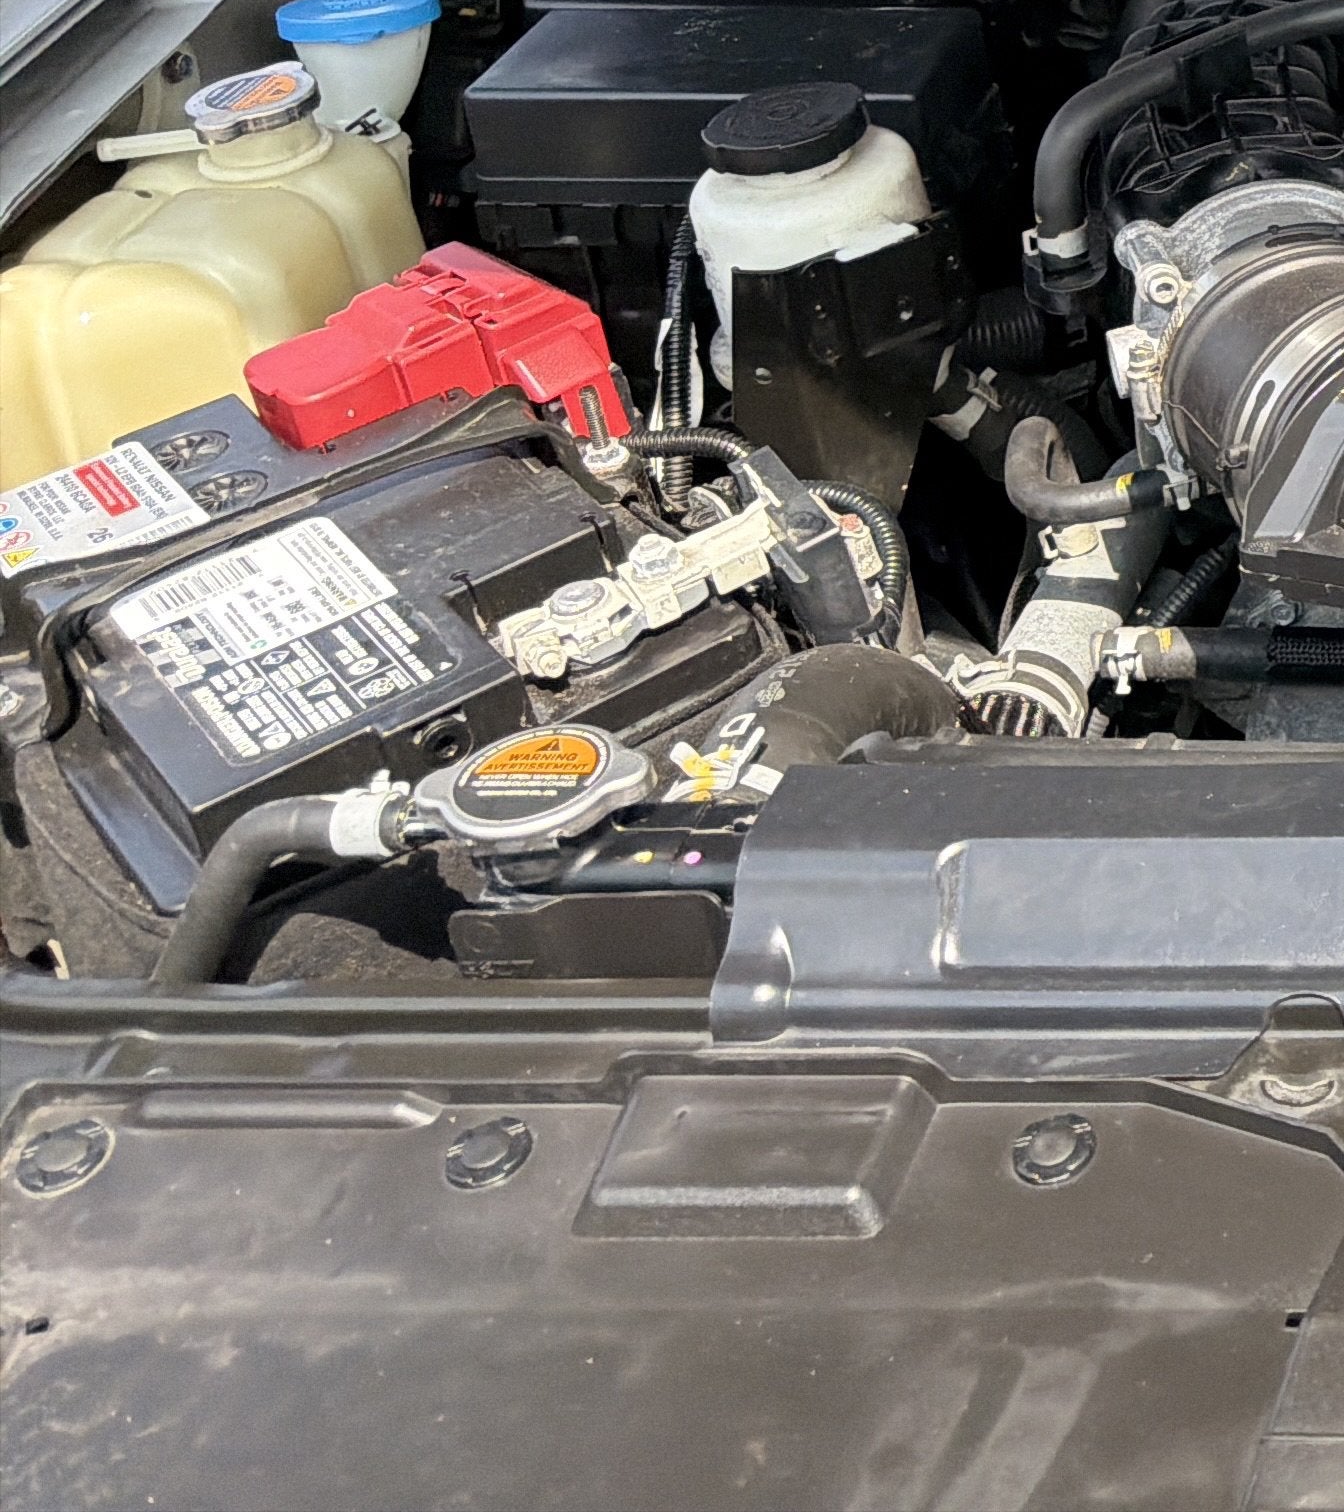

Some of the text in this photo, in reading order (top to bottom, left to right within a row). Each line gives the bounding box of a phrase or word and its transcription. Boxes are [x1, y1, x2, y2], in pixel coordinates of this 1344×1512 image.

[144, 473, 176, 502] NISSAN
[87, 527, 114, 544] 26
[509, 752, 579, 762] WARNING
[483, 762, 589, 771] AVERTISSEMENT
